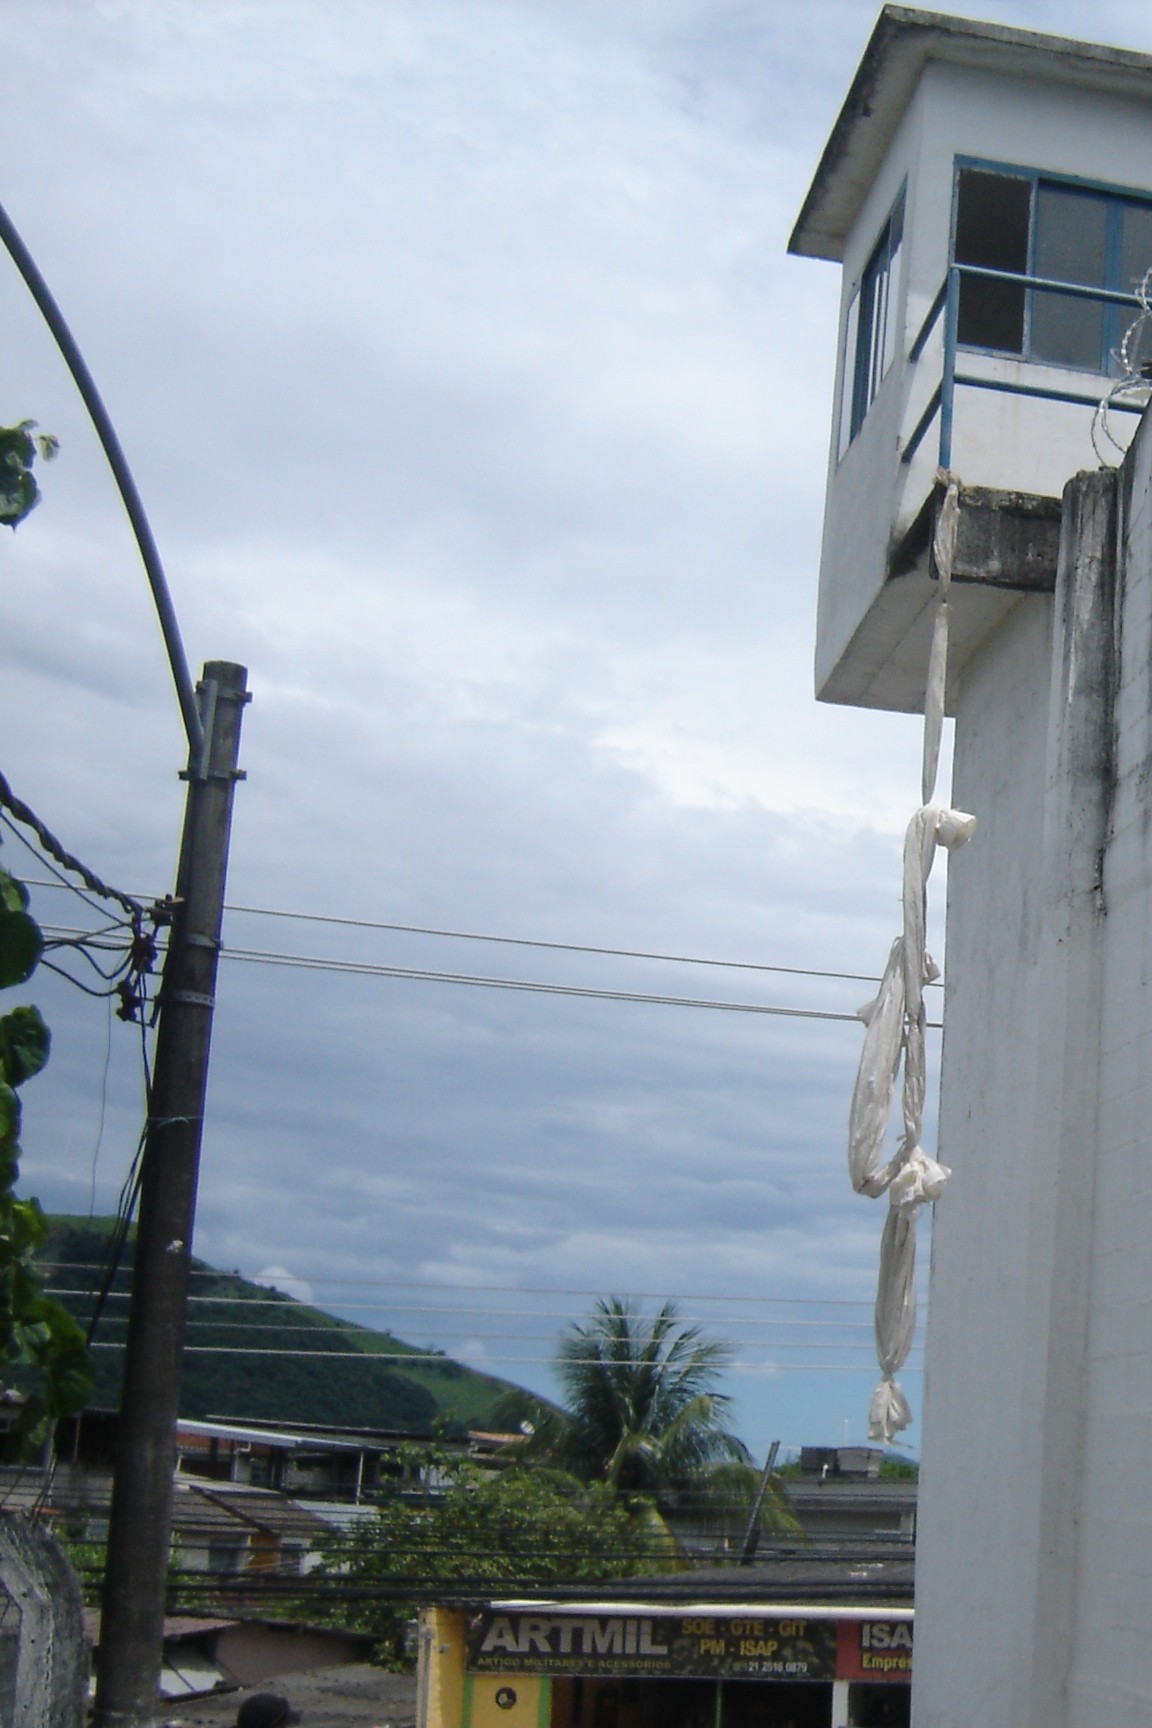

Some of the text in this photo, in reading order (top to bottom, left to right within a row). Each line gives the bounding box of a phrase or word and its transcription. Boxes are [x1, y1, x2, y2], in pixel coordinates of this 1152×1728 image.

[480, 1616, 669, 1655] ARTMIL
[778, 1620, 808, 1638] GIT
[699, 1639, 726, 1655] PM
[739, 1640, 779, 1657] ISAP
